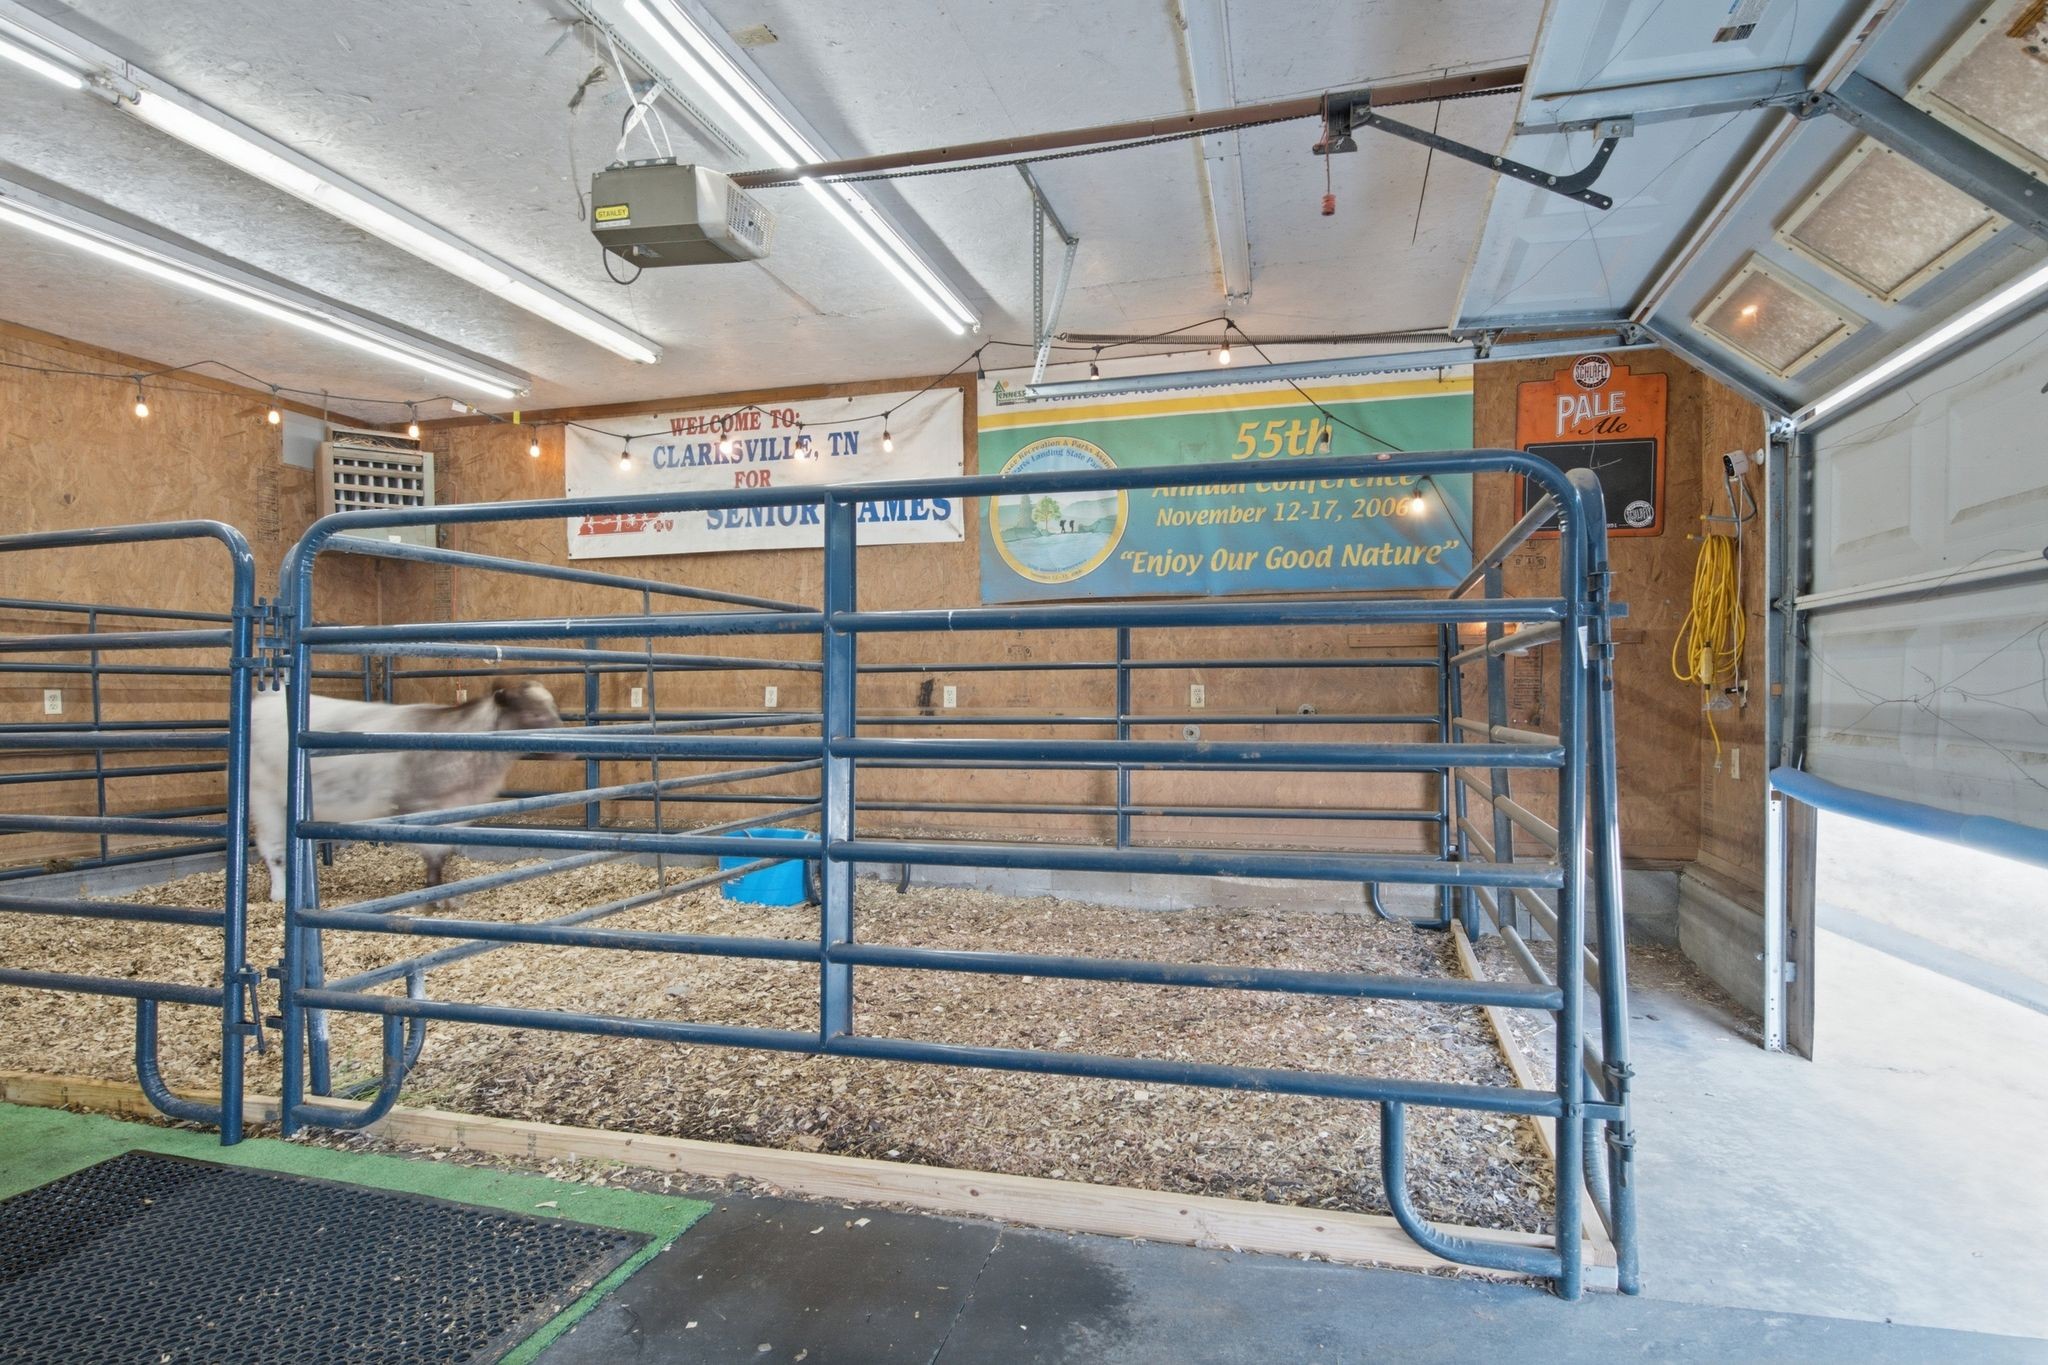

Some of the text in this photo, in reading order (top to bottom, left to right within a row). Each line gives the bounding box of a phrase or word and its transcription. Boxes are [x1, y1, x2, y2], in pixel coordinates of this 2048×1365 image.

[598, 208, 627, 218] STANLEY
[670, 408, 800, 436] WELCOME TO:
[1555, 391, 1626, 437] PALE
[1578, 416, 1630, 436] Ale
[652, 431, 860, 470] CLARKSVILLE, TN
[1231, 417, 1333, 460] 55th
[734, 469, 771, 489] FOR
[706, 497, 952, 531] SENIOR AMES
[1156, 496, 1411, 527] November 12-17, 2006
[1210, 546, 1258, 572] Our
[1264, 544, 1334, 570] Good
